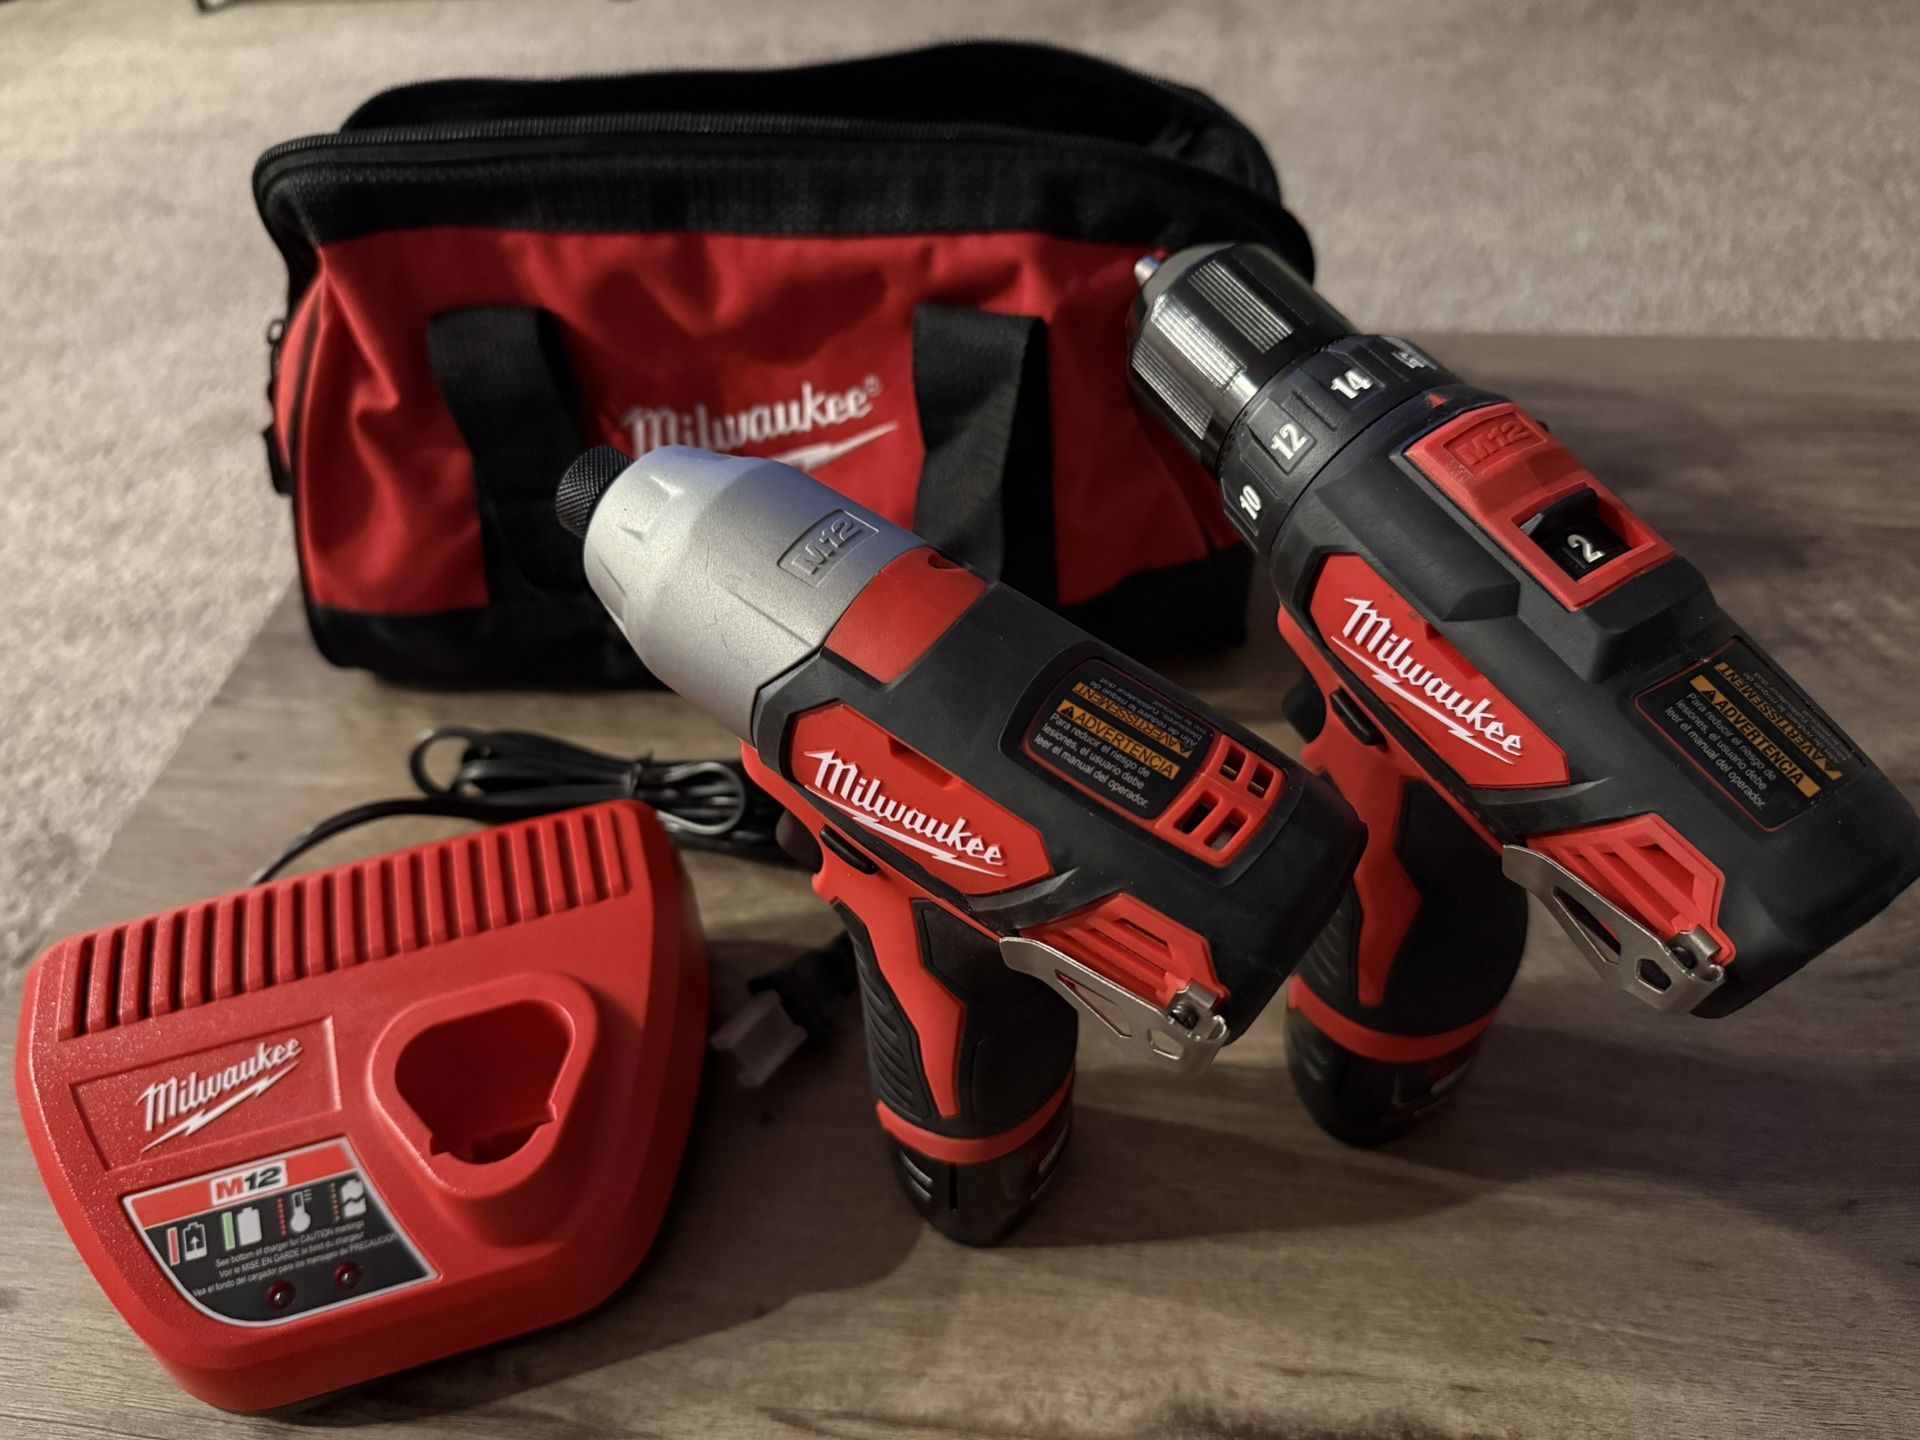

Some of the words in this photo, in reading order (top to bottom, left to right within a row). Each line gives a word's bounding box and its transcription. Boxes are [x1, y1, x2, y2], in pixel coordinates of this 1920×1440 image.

[1331, 369, 1374, 399] 14
[1271, 424, 1308, 461] 12
[1458, 420, 1533, 466] M12
[1239, 484, 1263, 520] 10
[790, 517, 864, 576] M12
[1567, 534, 1604, 563] 2
[1342, 597, 1523, 756] Milwaukee
[1074, 713, 1173, 776] ADVERTENCIA
[1076, 686, 1178, 747] AVERTISSEMENT
[1676, 699, 1708, 733] lesiones,
[1708, 733, 1720, 741] el
[1717, 741, 1746, 769] usuario
[1745, 769, 1767, 790] debe
[1687, 693, 1706, 712] Para
[1705, 711, 1733, 737] reducir
[1731, 737, 1743, 746] el
[1739, 745, 1765, 769] riesgo
[1764, 769, 1776, 780] de
[1716, 697, 1803, 784] ADVERTENCIA
[1720, 666, 1823, 760] AVERTISSEMENT
[1034, 734, 1052, 749] leer
[1052, 746, 1063, 755] el
[1061, 751, 1094, 774] manual
[1093, 771, 1109, 783] del
[1108, 780, 1148, 807] operador.
[1042, 723, 1077, 751] lesiones,
[1079, 747, 1090, 756] el
[1089, 753, 1121, 775] usuario
[1121, 772, 1144, 789] debe
[1050, 713, 1071, 730] Para
[1071, 727, 1101, 747] reducir
[1101, 745, 1111, 754] el
[1110, 750, 1137, 770] riesgo
[1137, 767, 1150, 777] de
[1665, 706, 1682, 723] leer
[1680, 723, 1692, 732] el
[1688, 731, 1719, 759] manual
[1716, 759, 1732, 772] del
[1728, 772, 1765, 809] operador.
[804, 748, 1005, 866] Milwaukee
[135, 1038, 303, 1132] Milwaukee
[216, 1166, 283, 1200] M12
[215, 1257, 230, 1268] See
[240, 1260, 260, 1272] MISE
